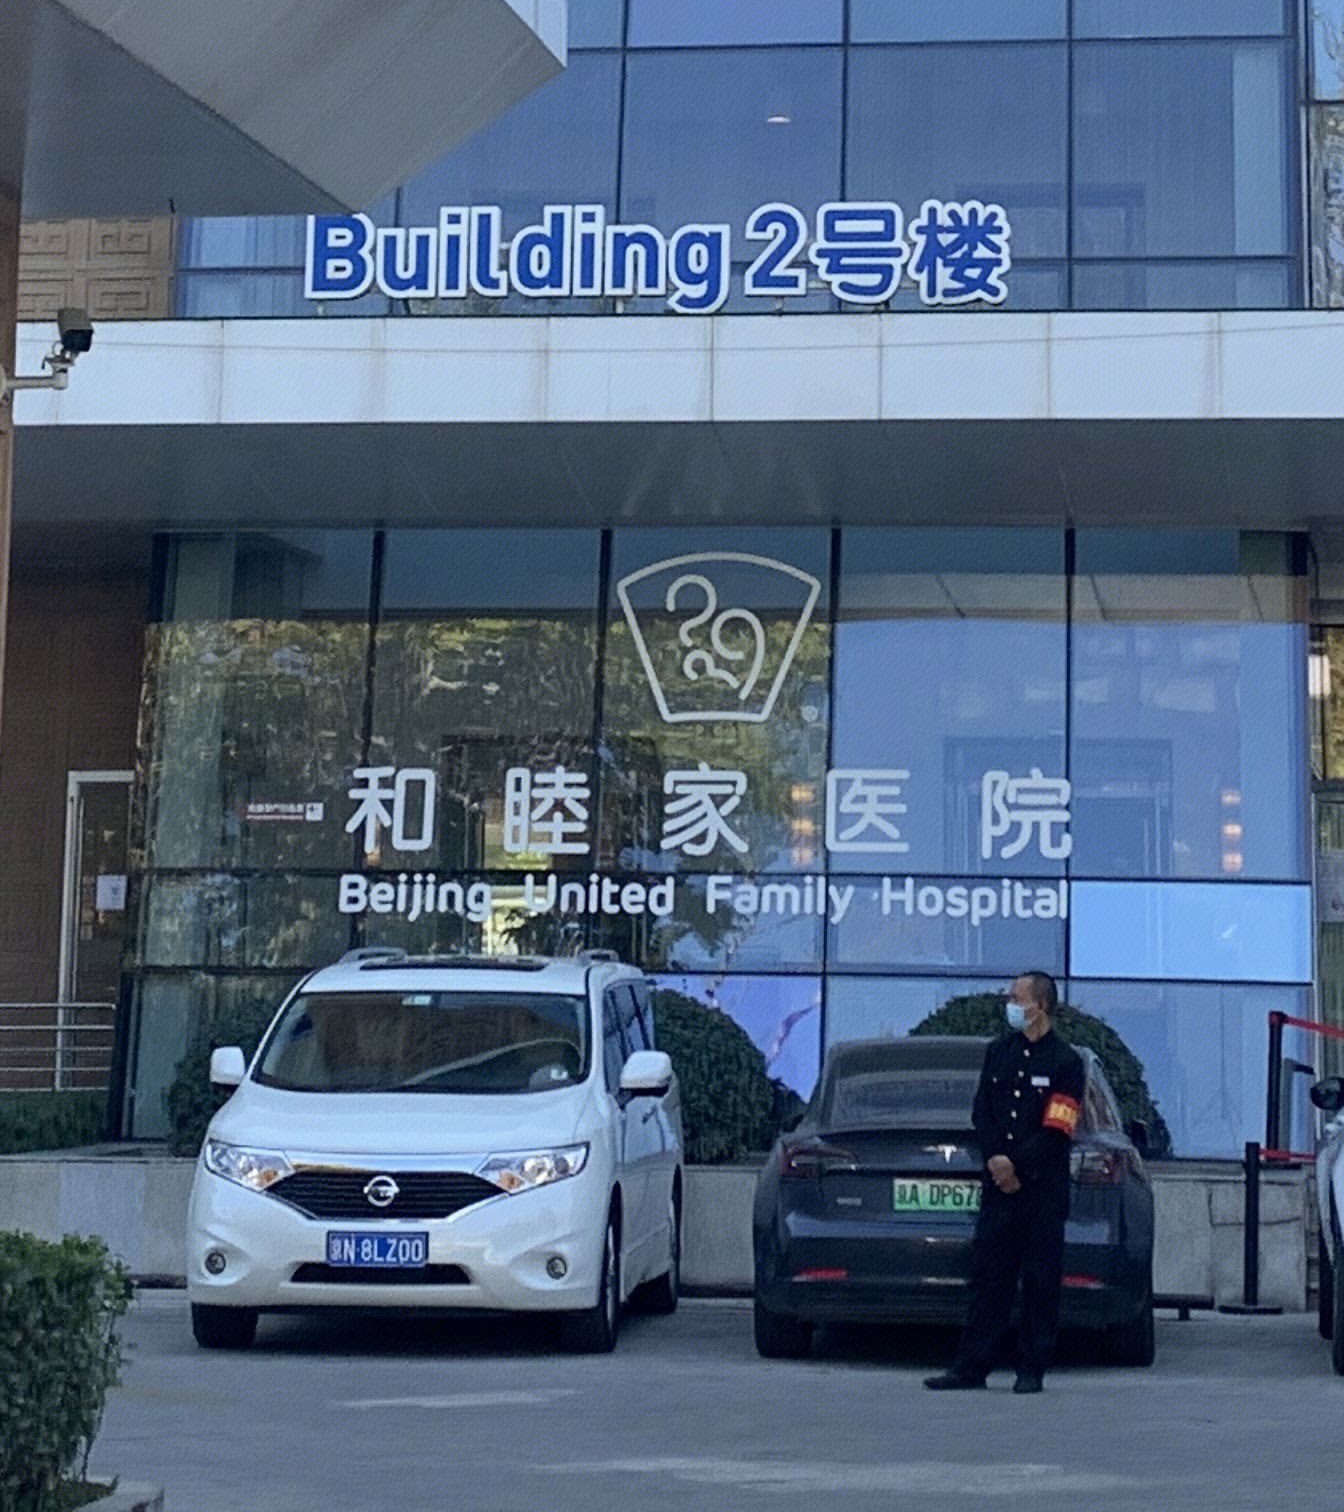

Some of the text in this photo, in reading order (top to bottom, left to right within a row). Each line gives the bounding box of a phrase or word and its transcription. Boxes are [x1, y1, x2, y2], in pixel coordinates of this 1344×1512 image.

[304, 199, 1011, 313] Building 2号楼
[345, 761, 1073, 859] 和睦家医院
[338, 872, 1069, 927] Beijing United Family Hospital
